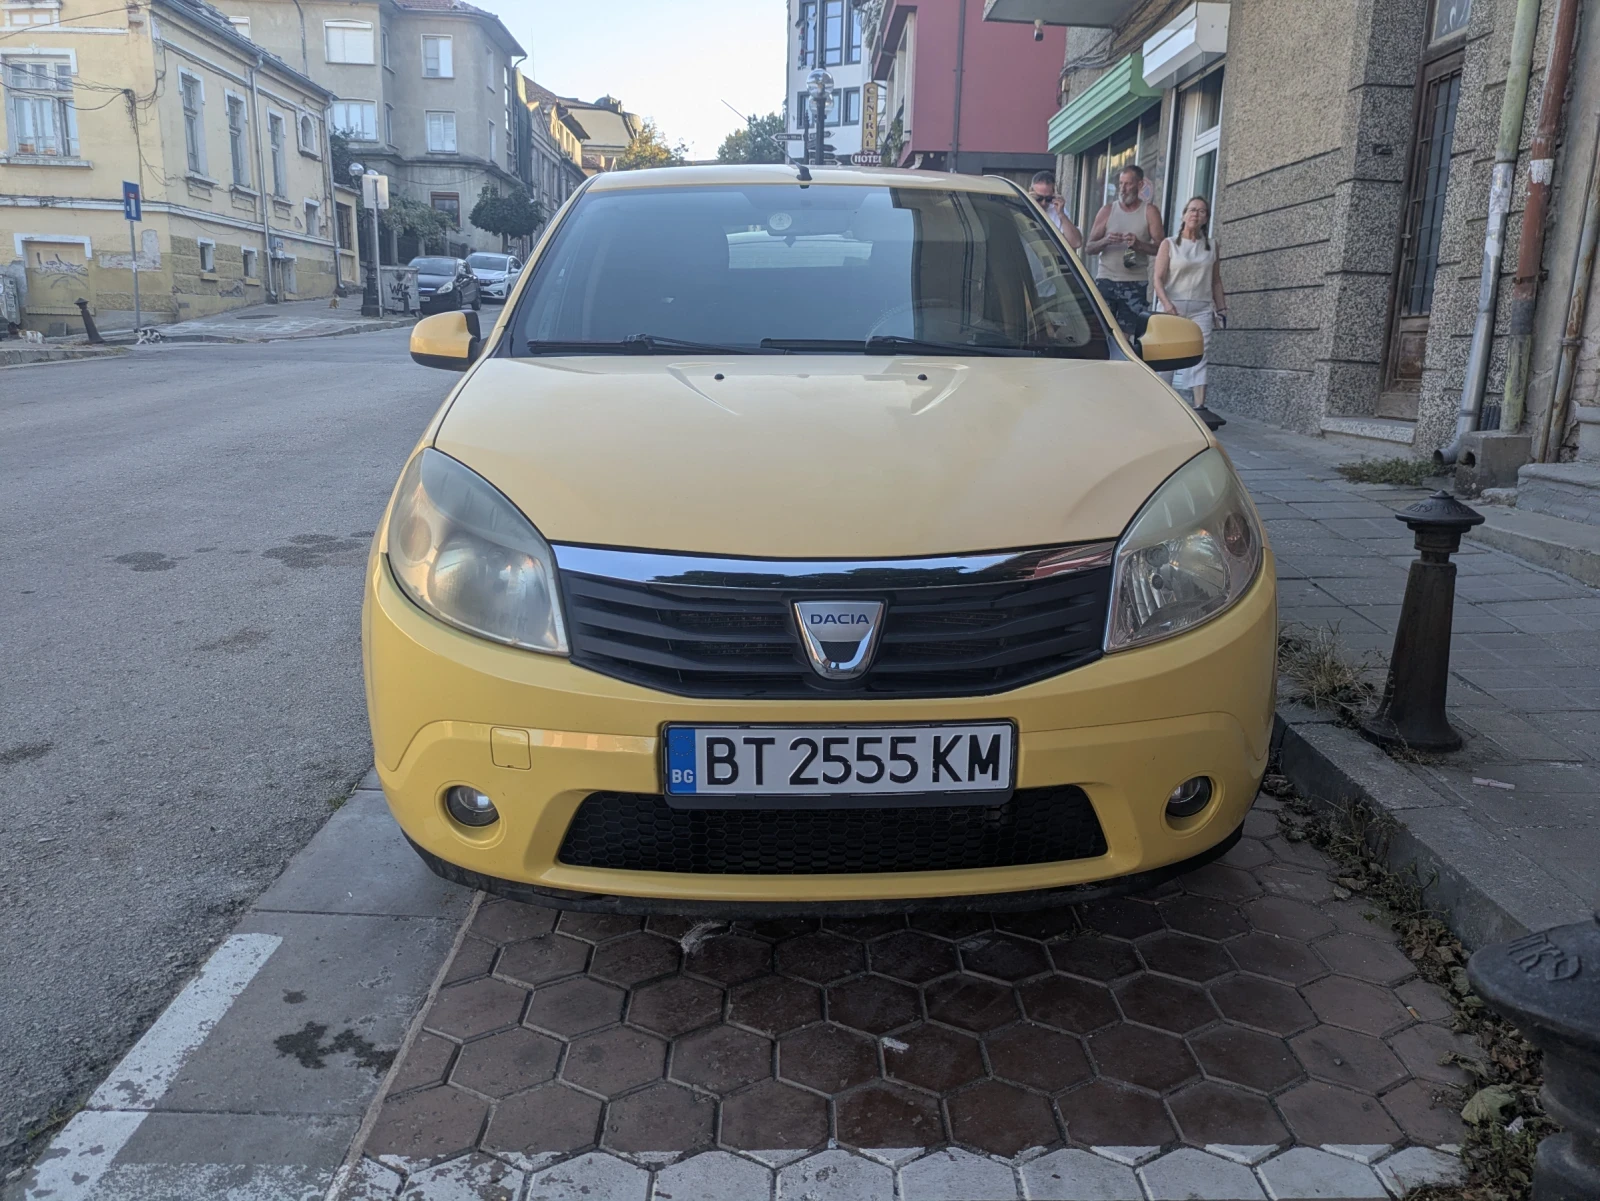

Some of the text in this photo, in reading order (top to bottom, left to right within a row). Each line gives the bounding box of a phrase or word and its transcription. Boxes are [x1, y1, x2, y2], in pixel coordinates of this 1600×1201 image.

[866, 87, 875, 147] CENTRAL
[810, 613, 870, 625] DACIA
[672, 769, 694, 784] BG
[706, 733, 1001, 786] BT 2555 KM
